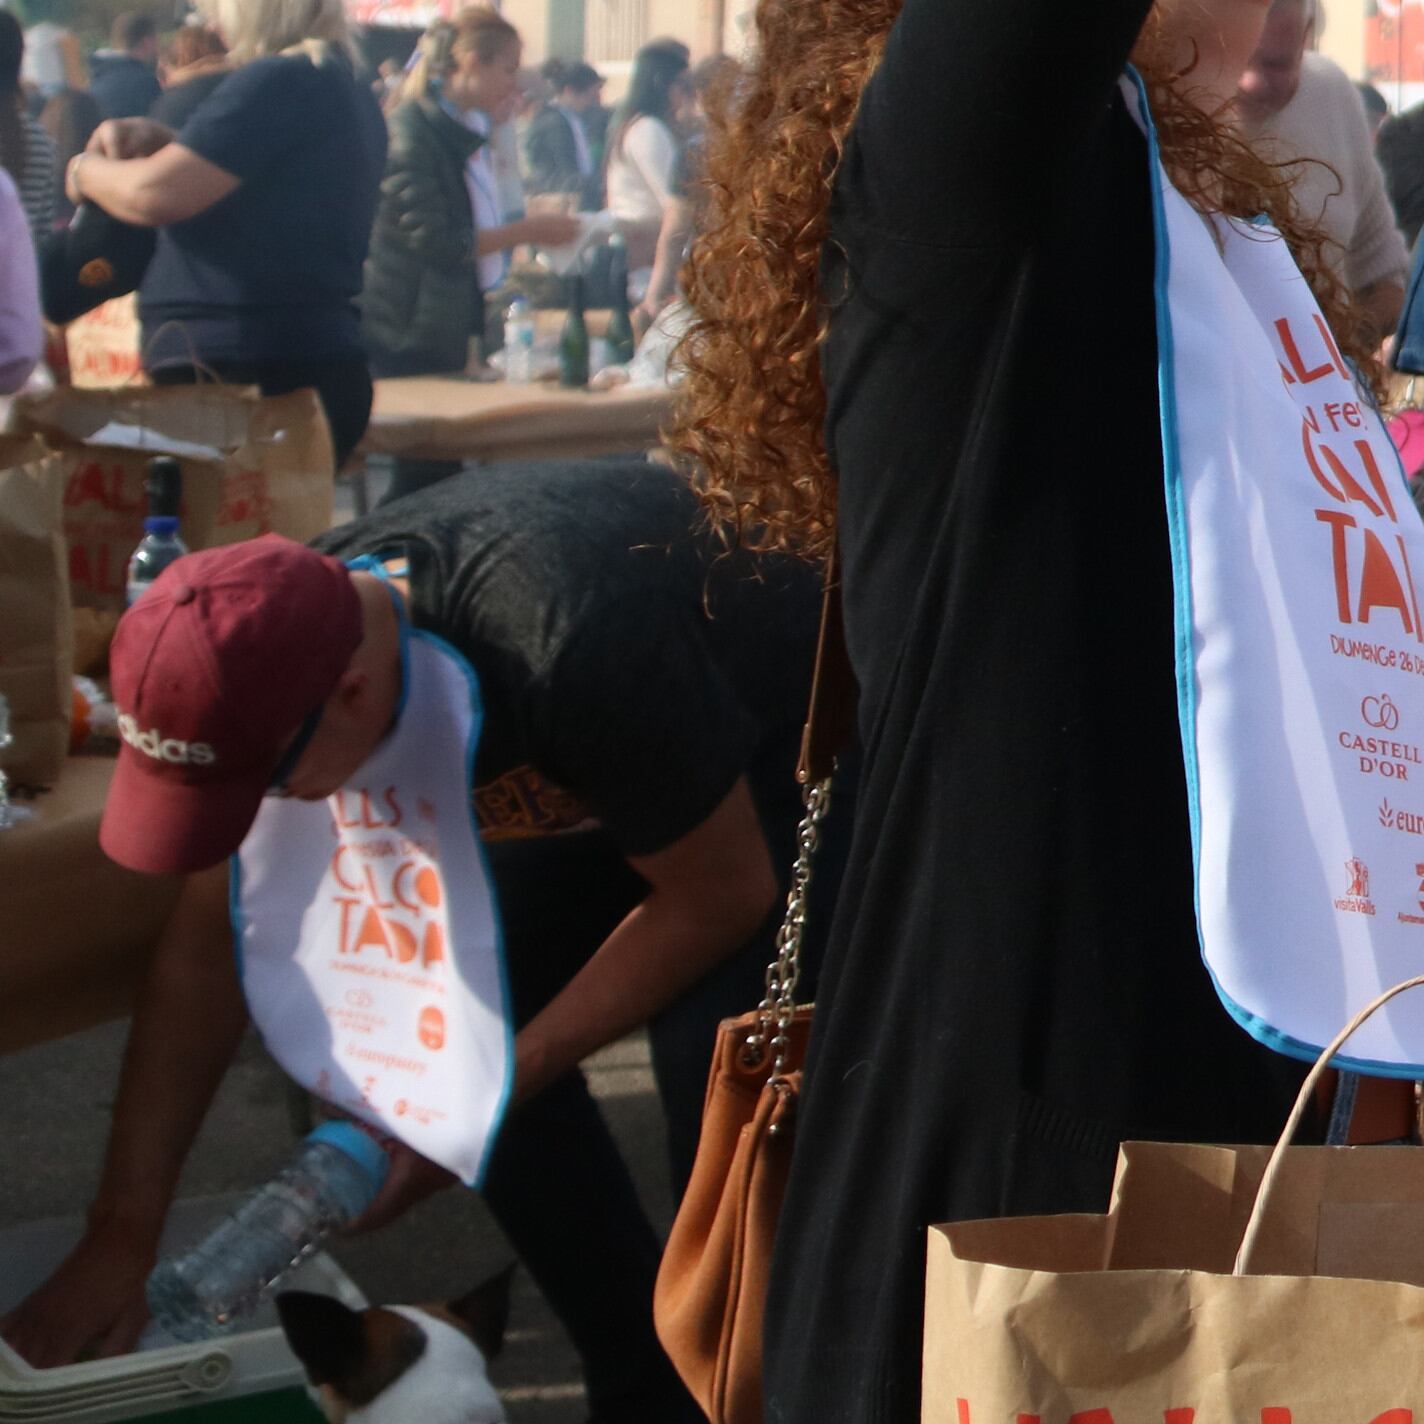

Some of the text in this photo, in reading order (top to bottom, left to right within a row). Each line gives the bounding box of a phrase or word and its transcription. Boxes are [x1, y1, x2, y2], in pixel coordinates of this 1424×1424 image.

[1314, 508, 1424, 643] TA
[1338, 731, 1423, 764] CASTELL
[1358, 756, 1409, 781] D'OR
